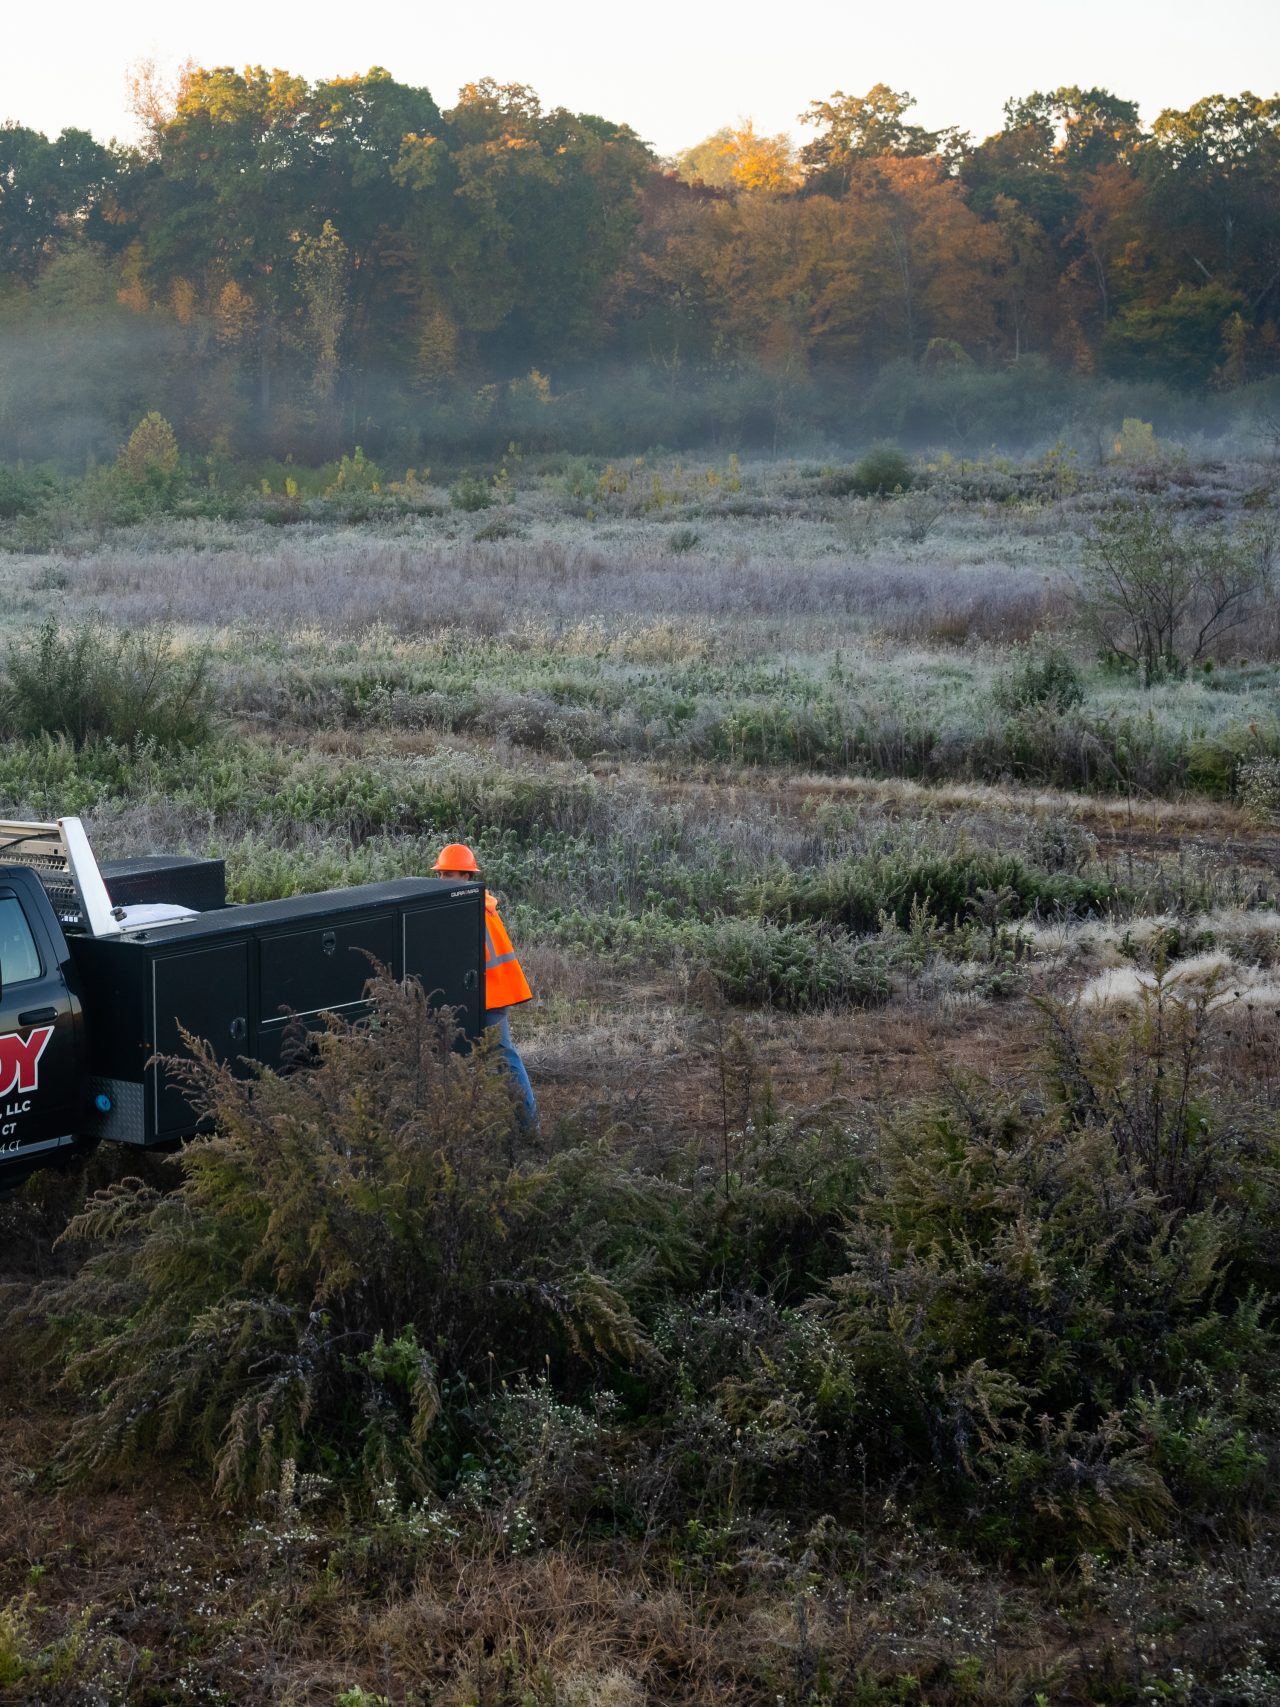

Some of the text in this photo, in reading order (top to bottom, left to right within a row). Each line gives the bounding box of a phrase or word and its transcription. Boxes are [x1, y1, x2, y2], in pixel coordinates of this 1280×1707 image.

[6, 1100, 31, 1116] LLC
[1, 1122, 17, 1135] CT
[8, 1140, 21, 1152] CT
